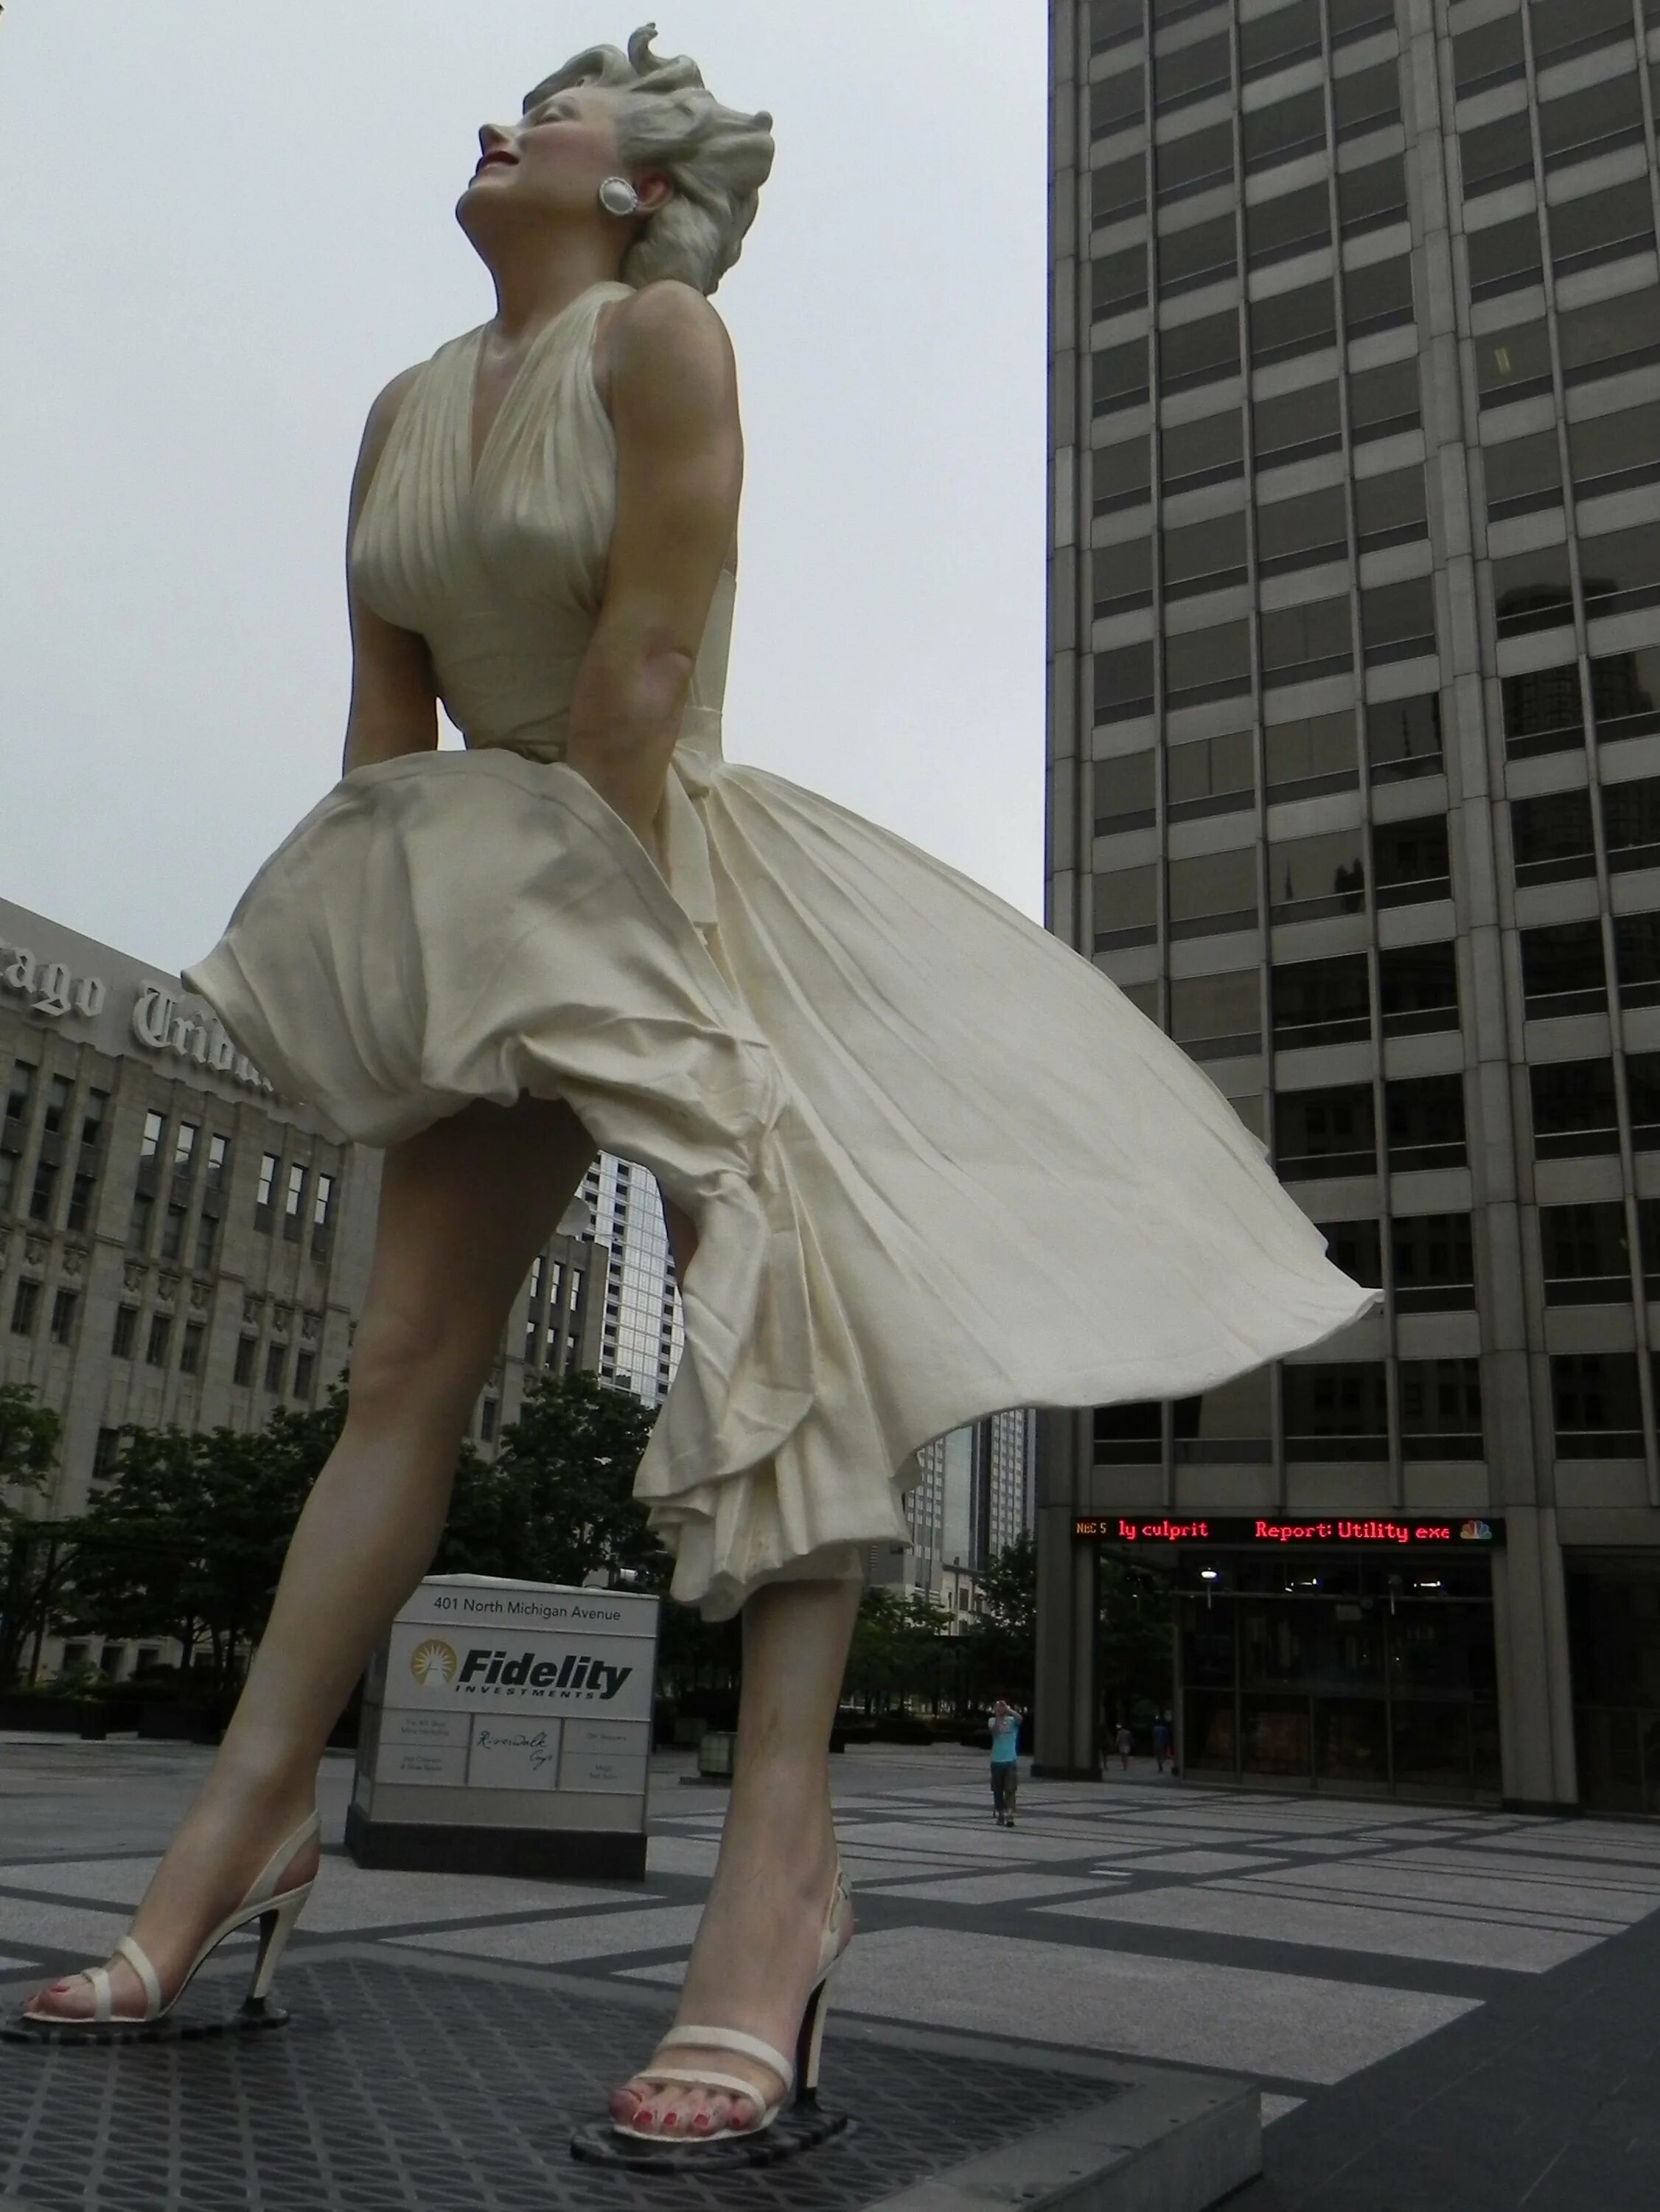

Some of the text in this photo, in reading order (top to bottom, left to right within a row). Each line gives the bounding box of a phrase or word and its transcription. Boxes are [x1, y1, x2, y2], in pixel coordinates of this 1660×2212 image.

[0, 939, 275, 1092] ago Tribu
[1076, 1522, 1106, 1534] NBC 5
[1118, 1520, 1209, 1540] ly culprit
[1255, 1521, 1333, 1542] Report:
[1338, 1522, 1409, 1543] Utility
[433, 1596, 621, 1621] 401 North Michigan Avenue
[458, 1649, 633, 1700] Fidelity
[455, 1684, 594, 1700] INVESTMENTS
